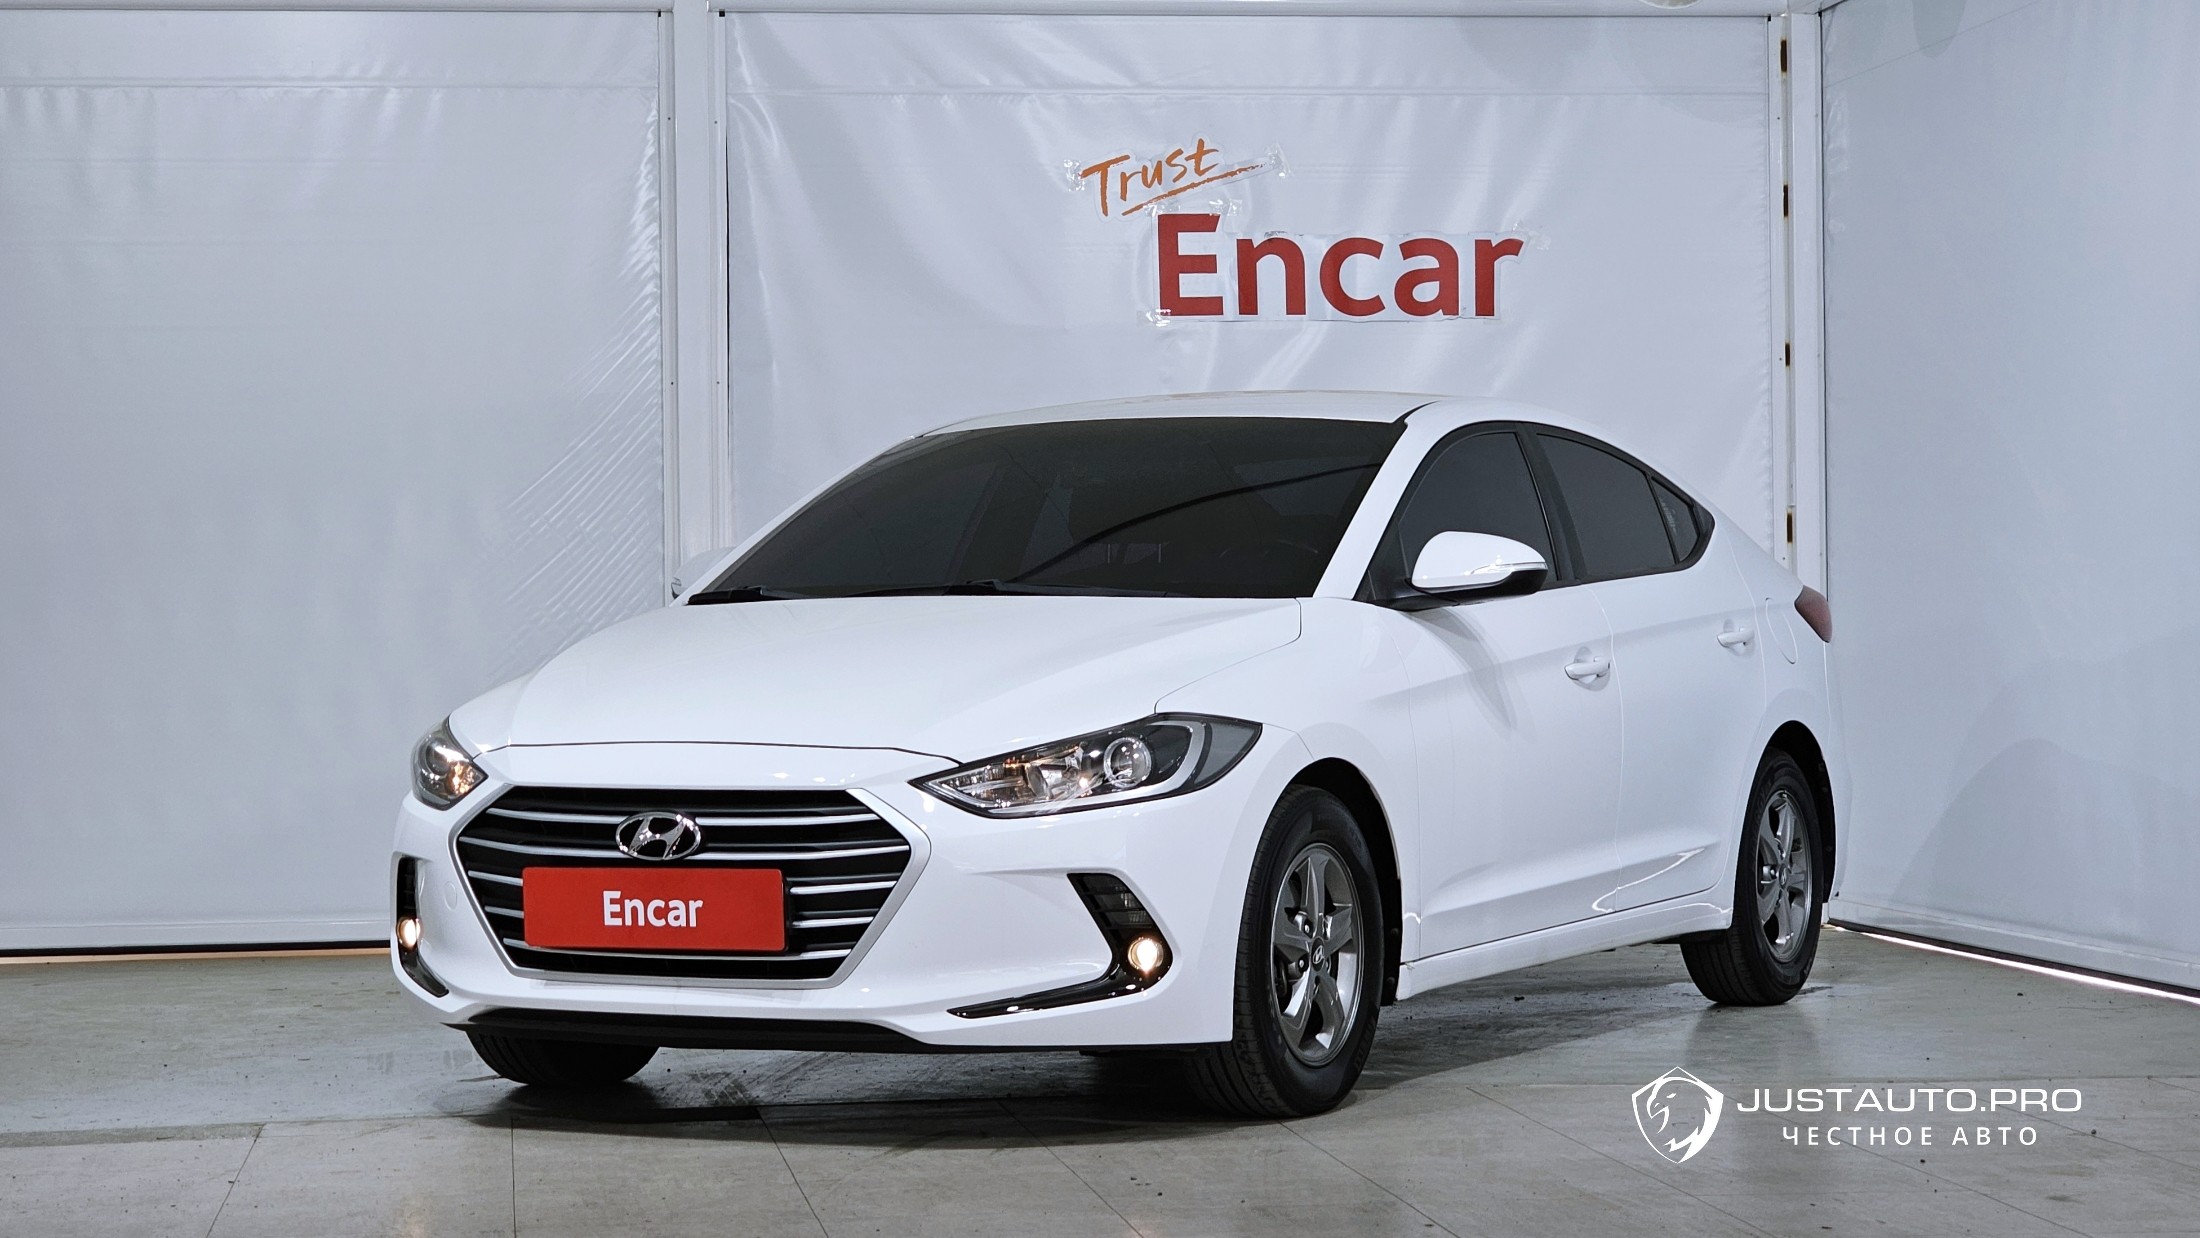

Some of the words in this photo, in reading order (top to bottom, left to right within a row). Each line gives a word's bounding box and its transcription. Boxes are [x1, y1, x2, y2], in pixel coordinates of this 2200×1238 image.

[1081, 138, 1220, 216] Trust
[1157, 213, 1525, 317] Encar
[602, 890, 704, 928] Encar
